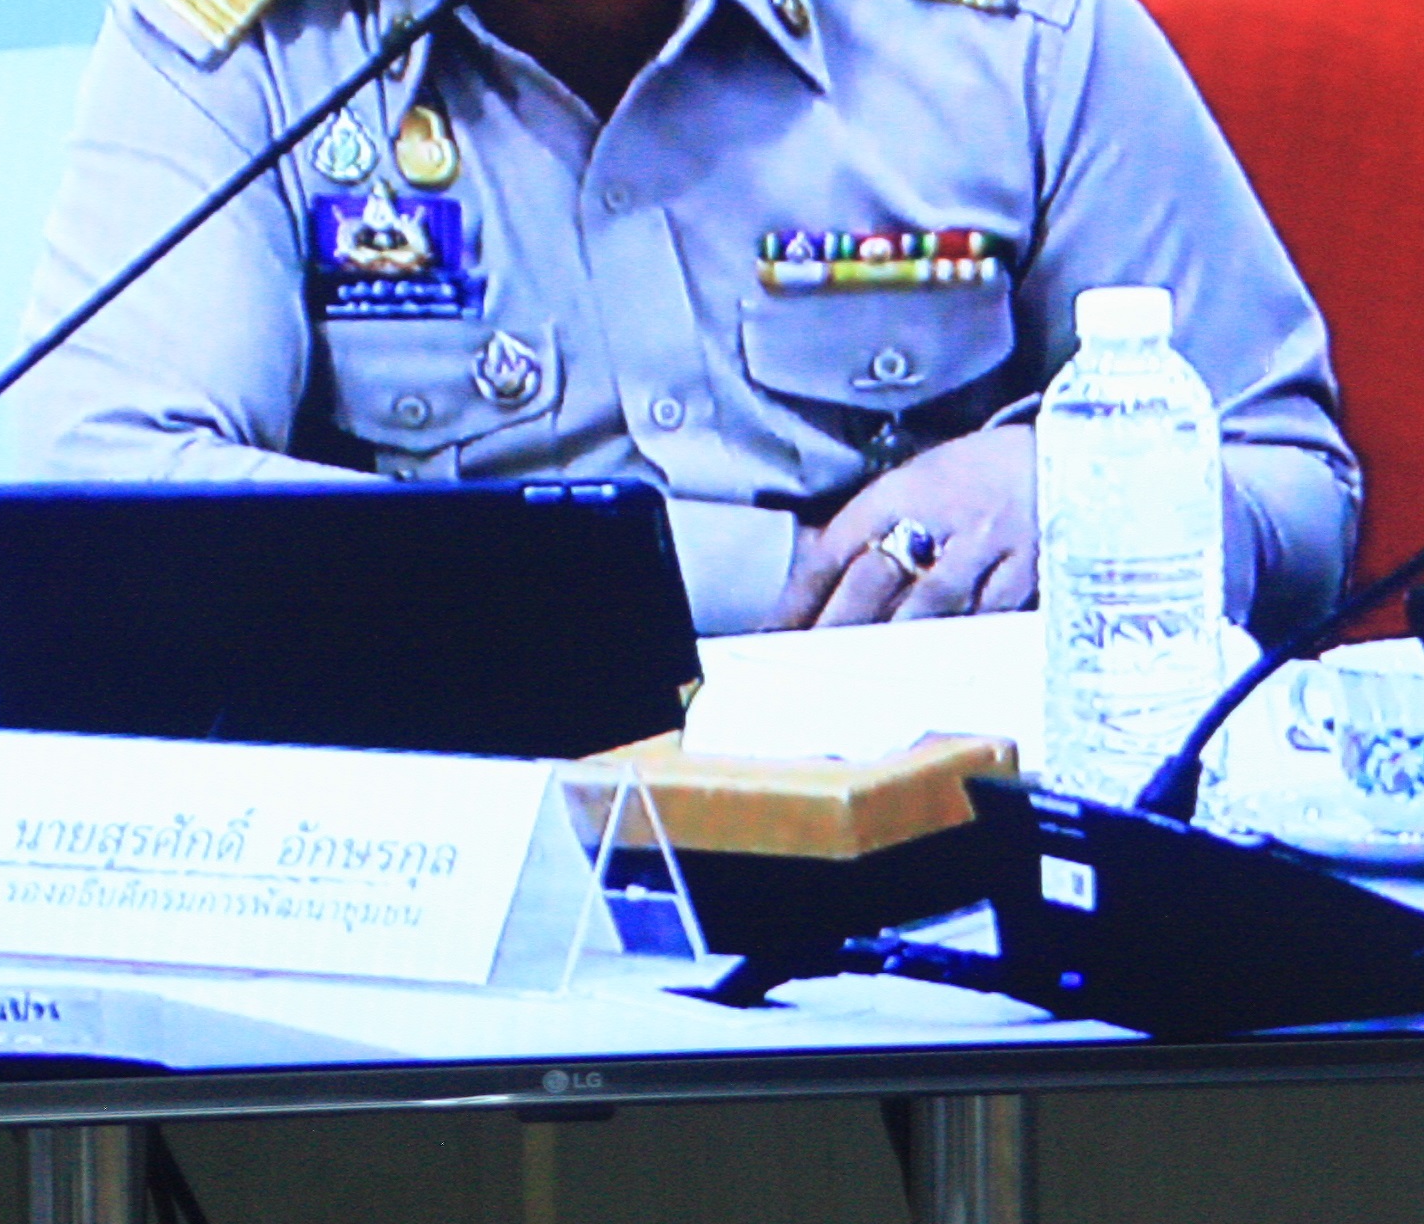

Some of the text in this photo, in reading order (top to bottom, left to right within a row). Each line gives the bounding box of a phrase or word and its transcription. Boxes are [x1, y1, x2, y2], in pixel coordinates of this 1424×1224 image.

[16, 806, 459, 889] นายสุรศักดิ์ อักษรกุล
[573, 1071, 603, 1088] LG
